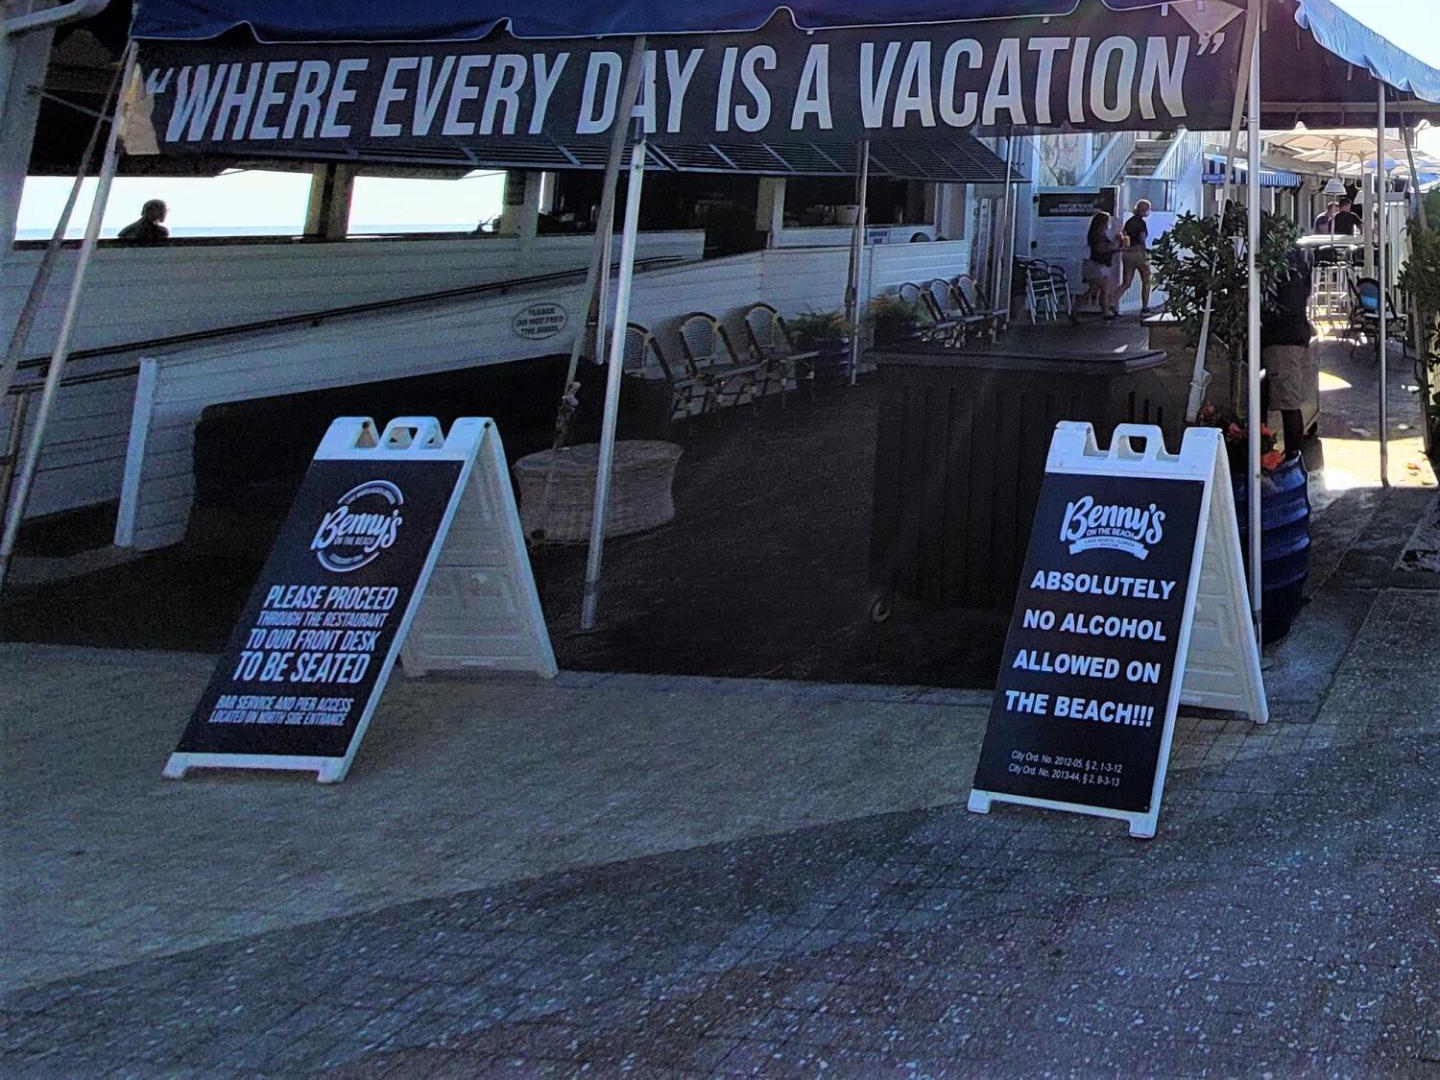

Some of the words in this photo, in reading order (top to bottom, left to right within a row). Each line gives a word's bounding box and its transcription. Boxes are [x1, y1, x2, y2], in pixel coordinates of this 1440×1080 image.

[370, 52, 571, 138] EVERY
[575, 48, 705, 134] DAY
[715, 45, 777, 132] IS
[790, 43, 833, 130] A
[310, 505, 403, 553] Benny's
[1060, 495, 1166, 544] Benny's
[263, 584, 327, 609] PLEASE
[323, 586, 399, 610] PROCEED
[1030, 570, 1176, 600] ABSOLUTELY
[256, 610, 304, 626] THROUGH
[302, 611, 325, 627] THE
[322, 612, 390, 628] RESTAURANT
[1022, 608, 1056, 630] NO
[1060, 612, 1167, 642] ALCOHOL
[245, 628, 267, 649] TO
[265, 629, 297, 650] OUR
[293, 629, 343, 651] FRONT
[340, 631, 382, 651] DESK
[232, 651, 263, 681] TO
[259, 652, 295, 682] BE
[290, 653, 371, 683] SEATED
[1012, 649, 1120, 679] ALLOWED
[1126, 660, 1161, 684] ON
[236, 695, 277, 710] SERVICE
[274, 696, 297, 711] AND
[316, 697, 354, 712] ACCESS
[1005, 690, 1049, 715] THE
[1054, 695, 1154, 728] BEACH!!!
[1008, 763, 1021, 775] City
[1011, 750, 1025, 761] City
